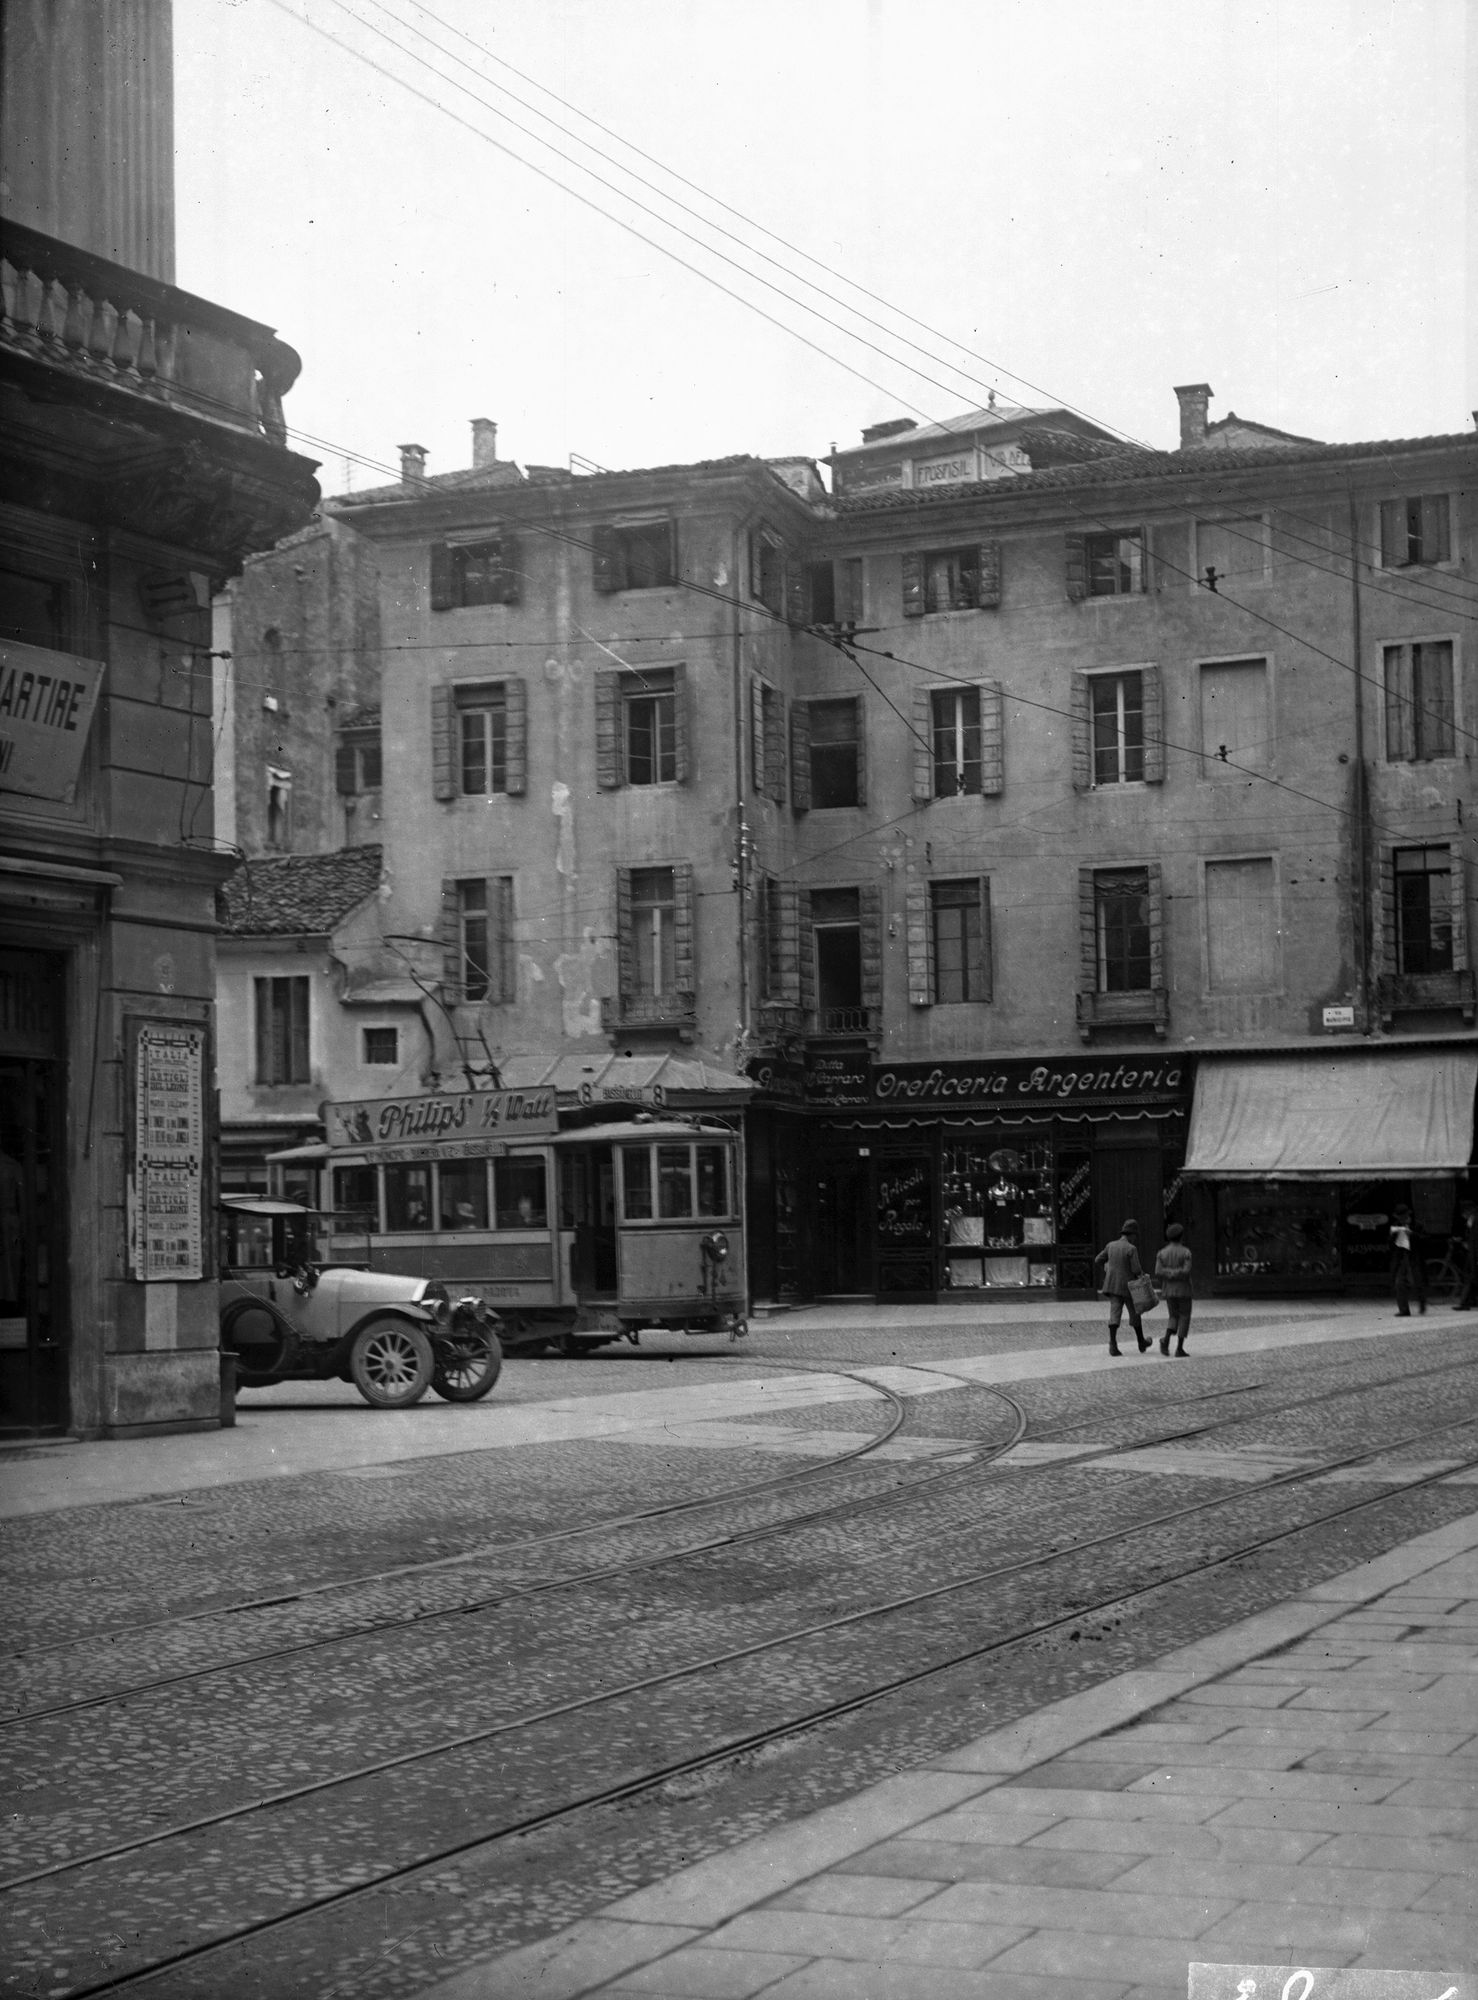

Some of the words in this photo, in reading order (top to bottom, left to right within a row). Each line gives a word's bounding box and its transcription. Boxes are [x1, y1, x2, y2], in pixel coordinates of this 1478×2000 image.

[0, 666, 86, 731] ARTIRE
[581, 1082, 592, 1107] 8
[652, 1084, 665, 1107] 8
[875, 1068, 1008, 1097] Oreficeria
[1018, 1065, 1181, 1097] Argenteria
[505, 1093, 553, 1122] Watt
[877, 1168, 923, 1209] Articoli
